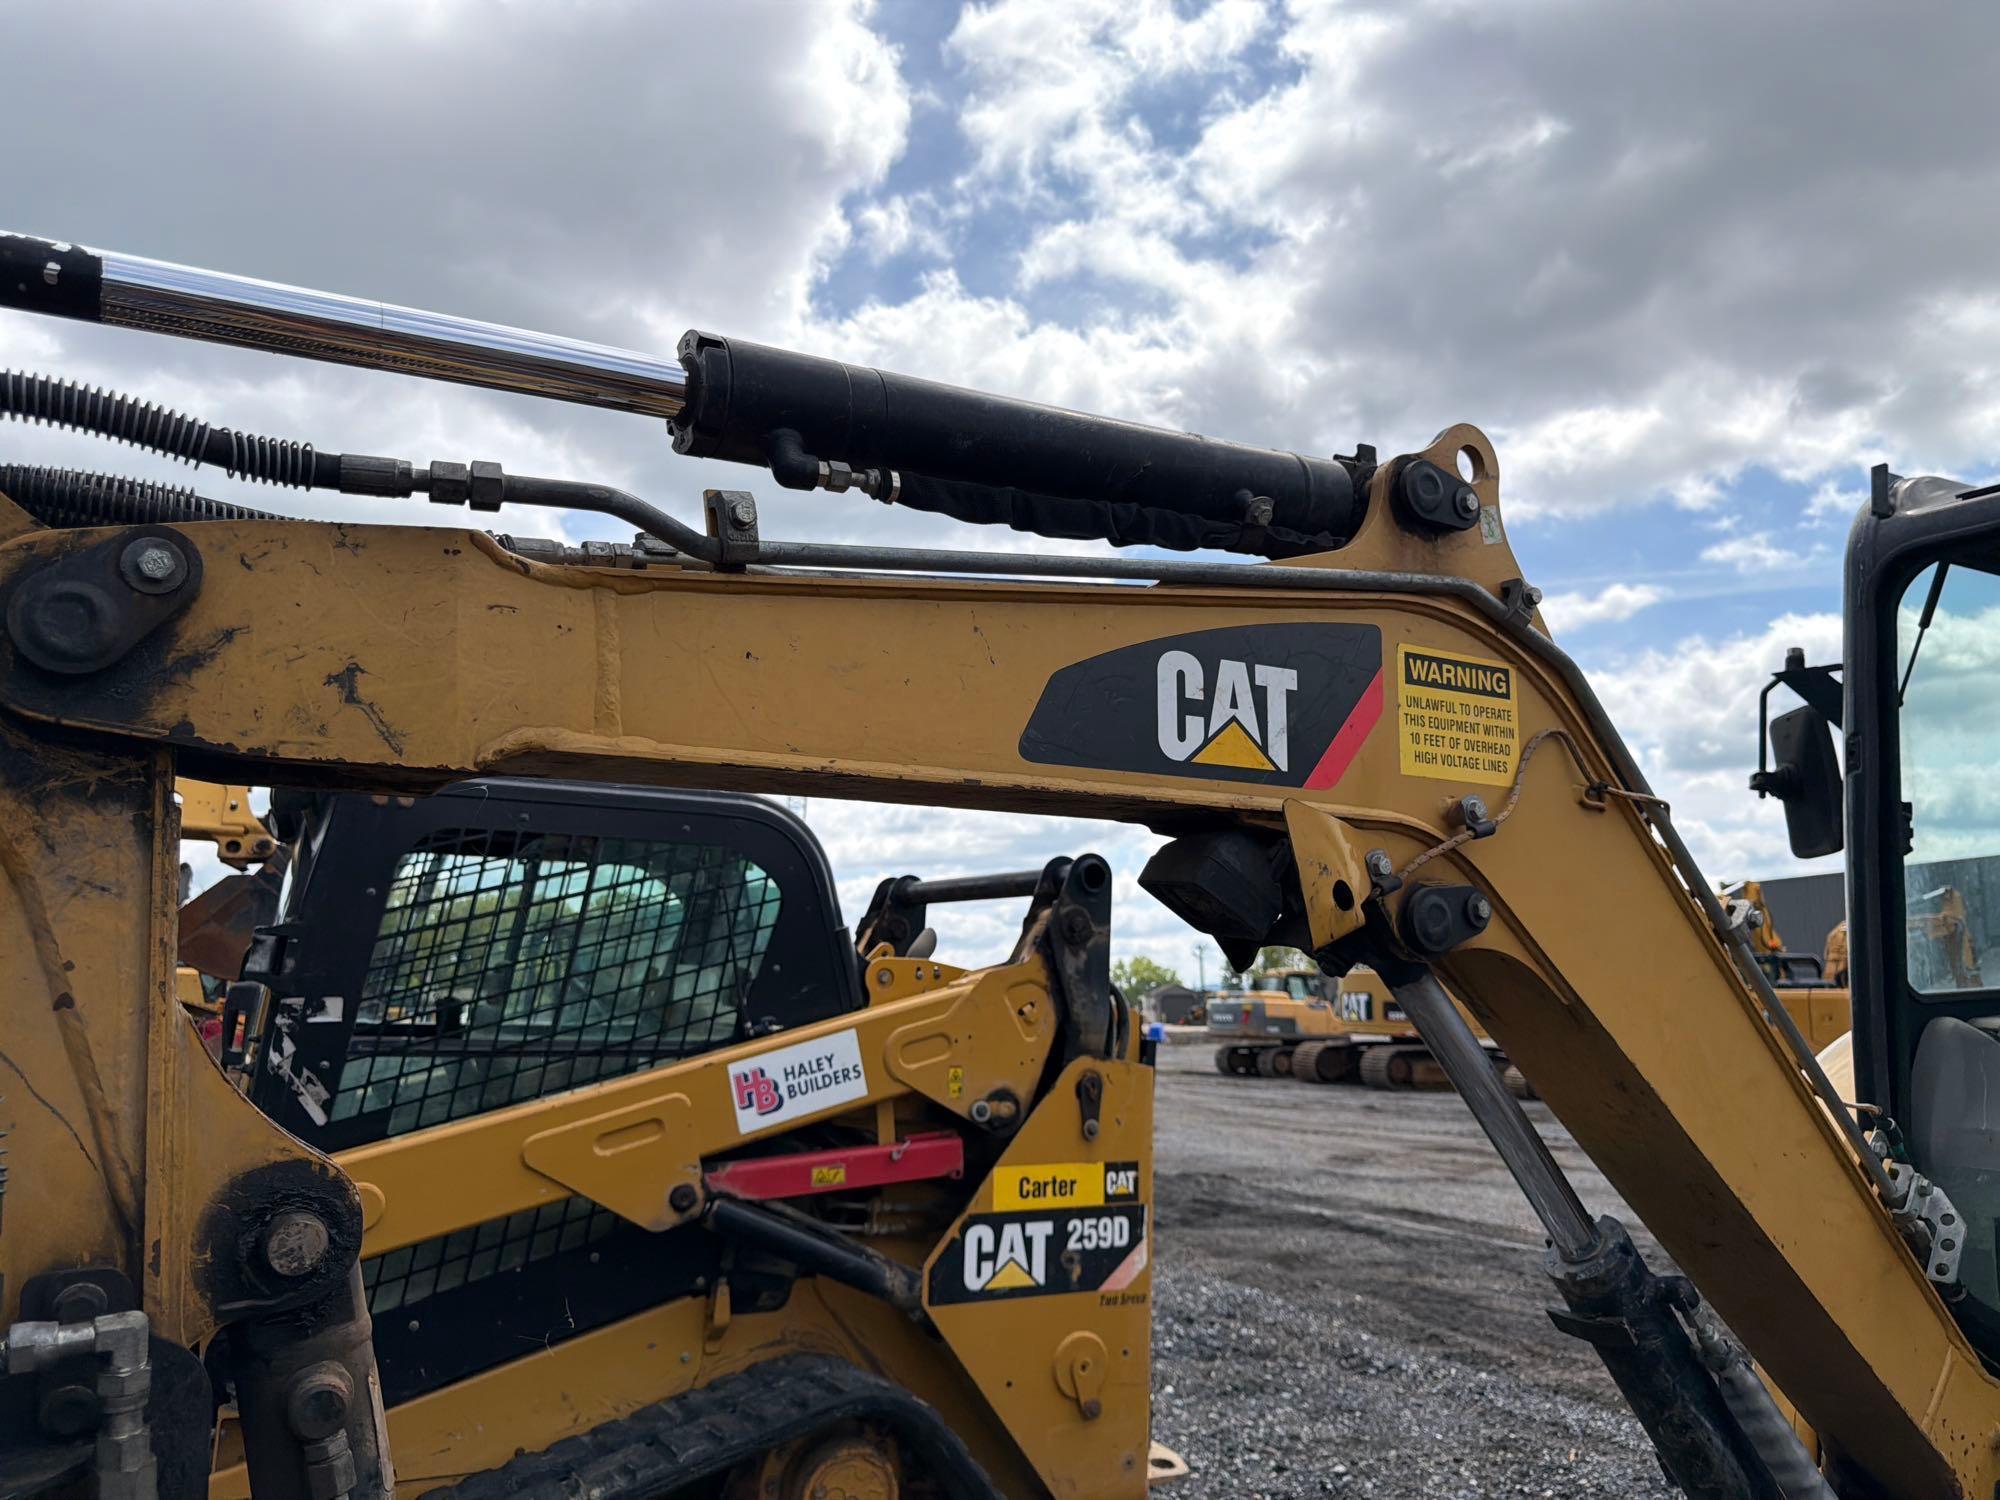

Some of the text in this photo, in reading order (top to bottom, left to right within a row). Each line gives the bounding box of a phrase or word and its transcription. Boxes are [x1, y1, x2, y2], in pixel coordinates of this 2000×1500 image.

[1409, 658, 1507, 694] WARNING
[1157, 650, 1298, 772] CAT
[1405, 695, 1512, 722] UNLAWFUL TO OPERATE
[1404, 713, 1515, 740] THIS EQUIPMENT WITHIN
[1410, 732, 1511, 756] 10 FEET OF OVERHEAD
[1414, 750, 1508, 774] HIGH VOLTAGE LINES
[784, 1053, 835, 1082] HALEY
[786, 1063, 862, 1100] BUILDERS
[733, 1067, 784, 1116] HB
[1019, 1176, 1077, 1199] Carter
[1106, 1171, 1137, 1195] CAT
[963, 1216, 1130, 1292] CAT 259D
